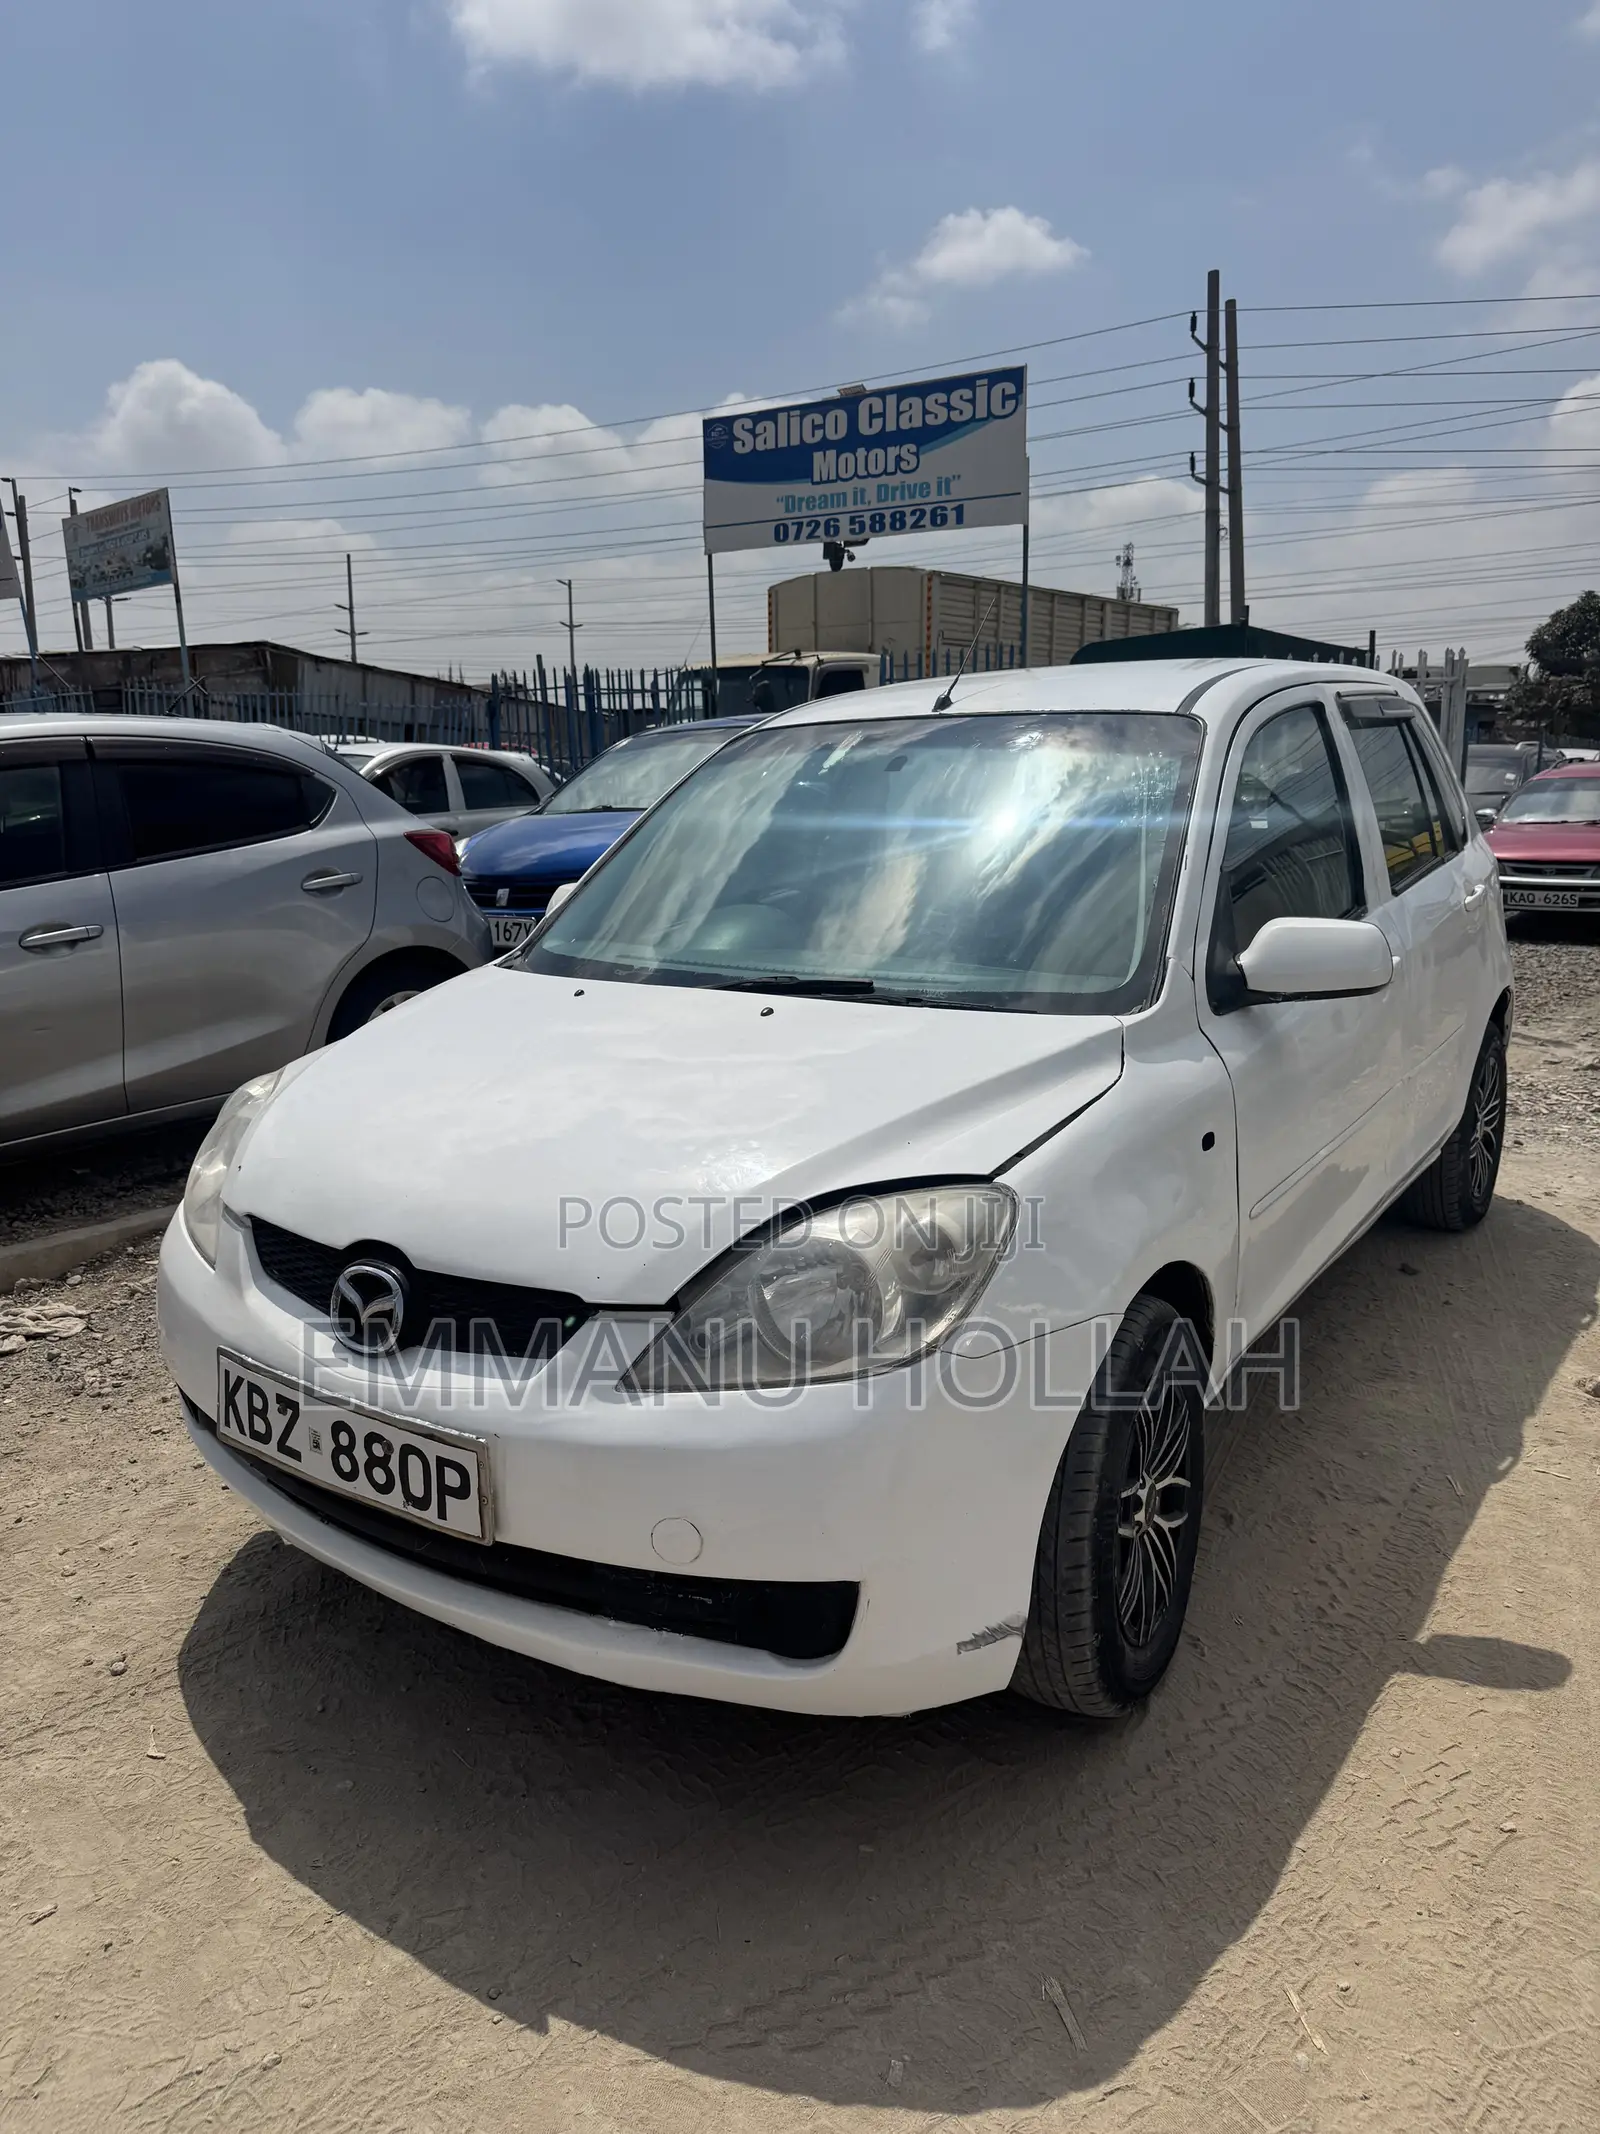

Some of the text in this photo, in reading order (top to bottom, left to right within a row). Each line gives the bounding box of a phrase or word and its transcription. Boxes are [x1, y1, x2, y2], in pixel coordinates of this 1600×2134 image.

[733, 407, 848, 454] Salico
[858, 378, 1017, 436] Classic
[812, 443, 918, 482] Motors
[852, 485, 872, 507] it,
[876, 478, 931, 503] Drive
[774, 503, 965, 543] 0726 588261
[1509, 892, 1578, 905] KAQ 626S
[224, 1368, 472, 1522] KBZ 880P
